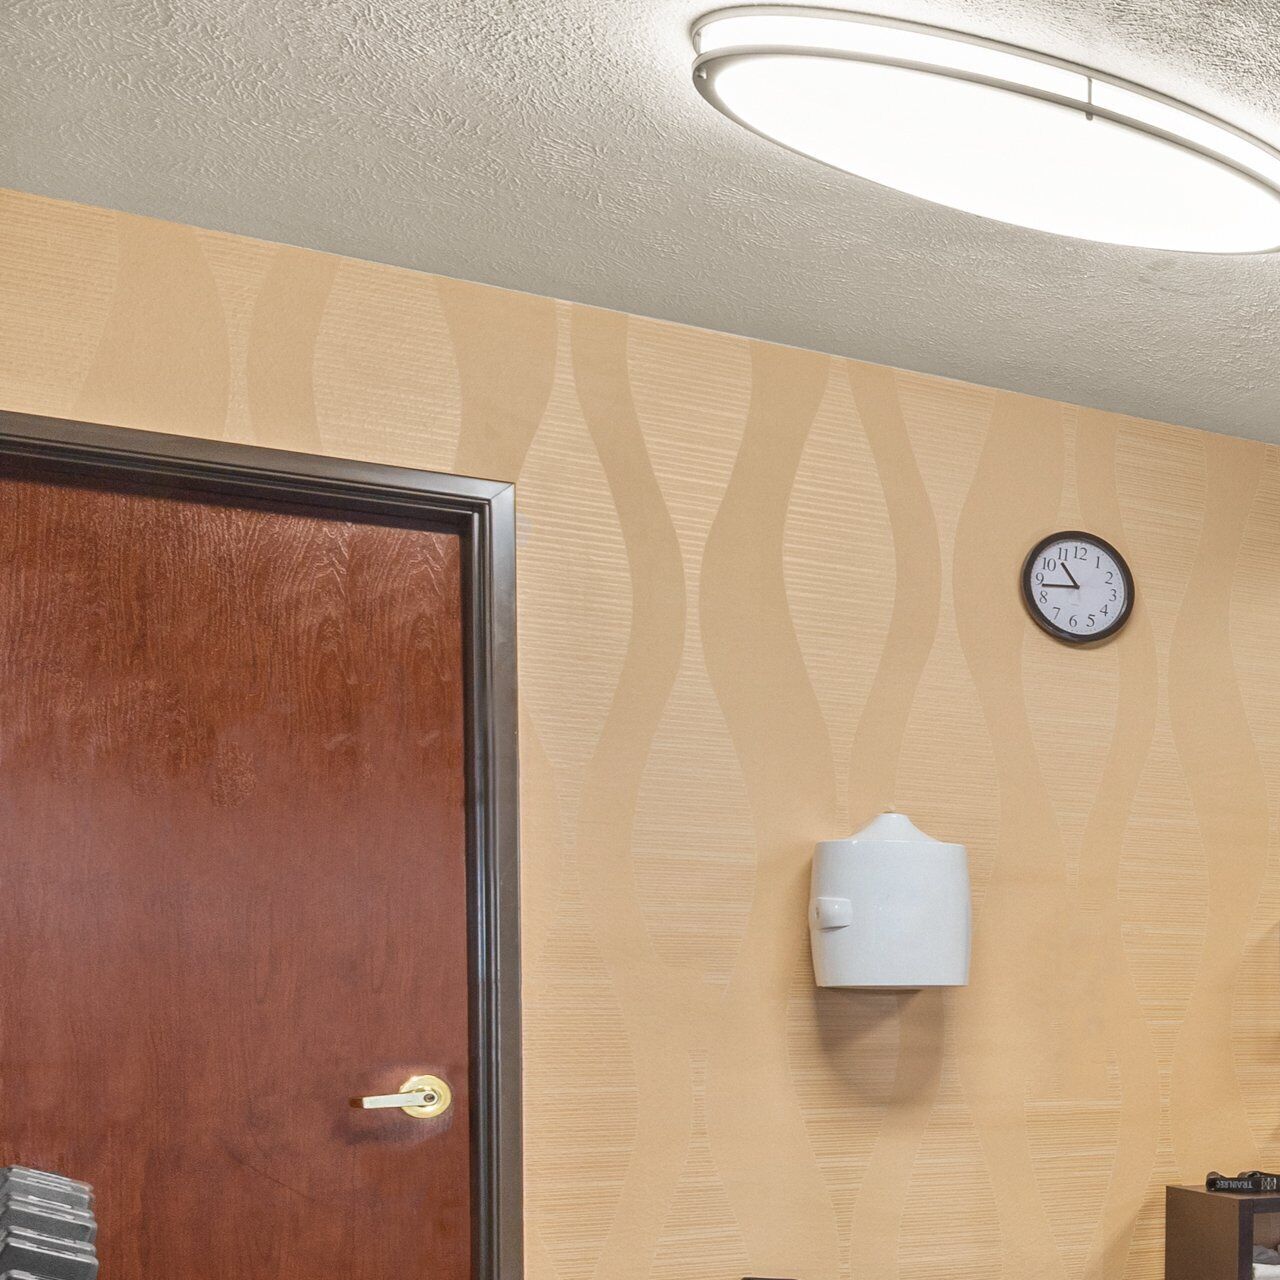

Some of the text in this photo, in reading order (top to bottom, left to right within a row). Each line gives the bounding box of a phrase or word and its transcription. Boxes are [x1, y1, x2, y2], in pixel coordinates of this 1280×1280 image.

[1058, 547, 1069, 561] 11
[1074, 546, 1088, 561] 12
[1042, 557, 1057, 572] 10
[1095, 556, 1100, 569] 1
[1035, 572, 1045, 586] 9
[1105, 571, 1113, 585] 2
[1039, 590, 1048, 604] 8
[1109, 588, 1117, 602] 3
[1053, 606, 1061, 620] 7
[1100, 604, 1108, 617] 4
[1069, 614, 1078, 628] 6
[1086, 613, 1096, 628] 5
